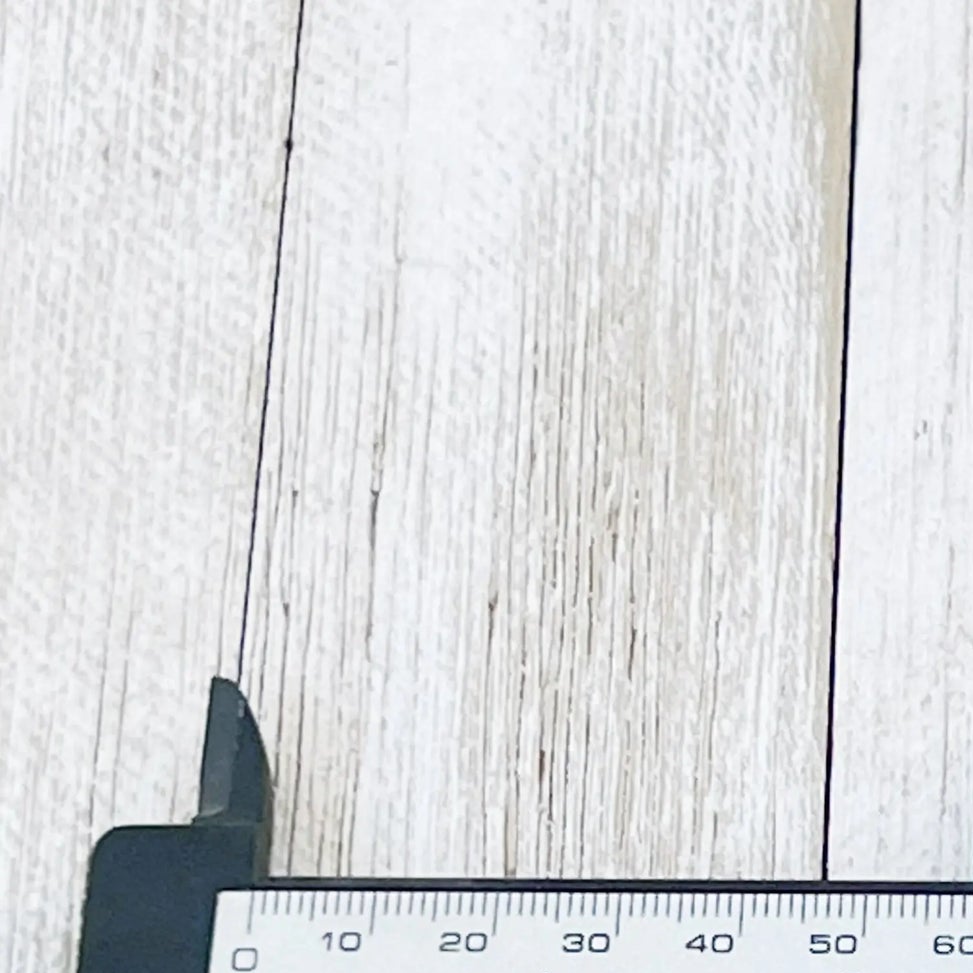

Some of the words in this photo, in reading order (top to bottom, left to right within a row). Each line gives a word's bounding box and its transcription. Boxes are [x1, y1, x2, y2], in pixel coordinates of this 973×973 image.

[231, 947, 258, 972] 0
[321, 932, 362, 952] 10
[439, 932, 488, 952] 20
[562, 933, 610, 953] 30
[685, 934, 734, 953] 40
[809, 934, 857, 954] 50
